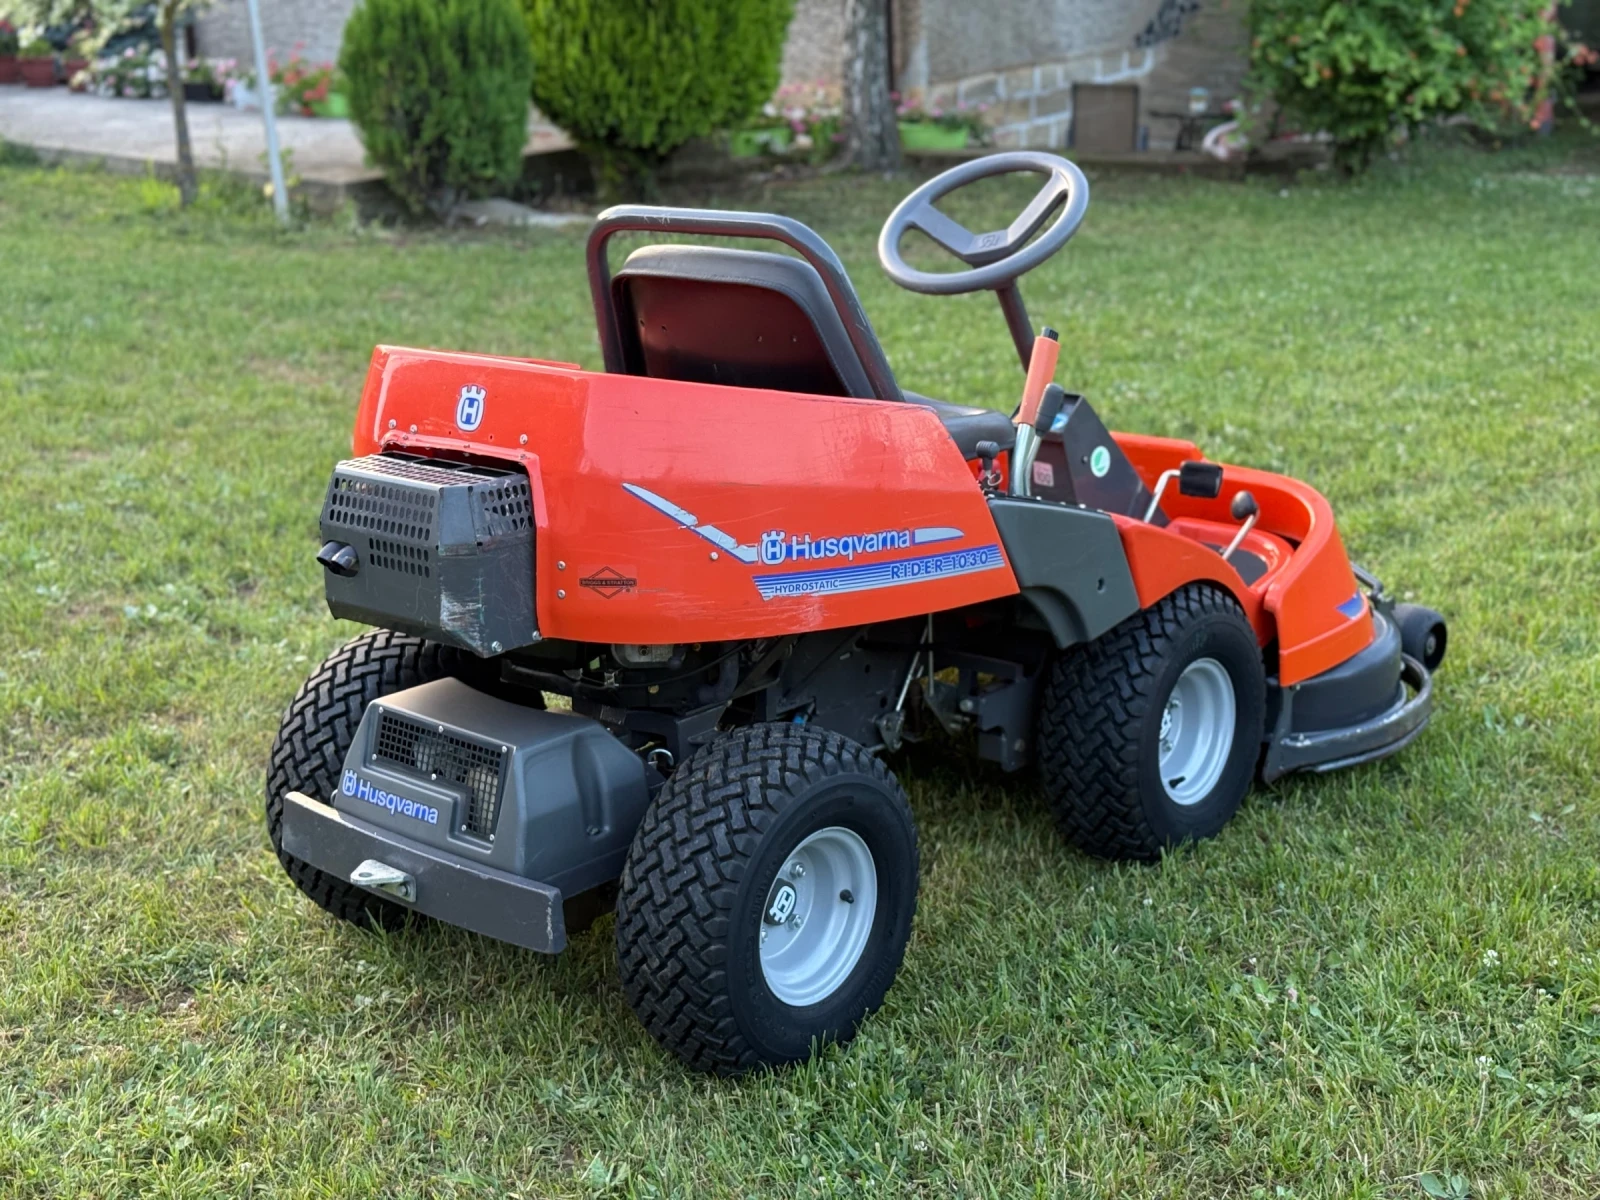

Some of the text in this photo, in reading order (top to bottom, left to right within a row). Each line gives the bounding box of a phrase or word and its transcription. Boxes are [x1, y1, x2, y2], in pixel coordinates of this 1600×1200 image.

[791, 529, 910, 561] Husqvarna
[891, 551, 988, 580] RIDER 1030
[774, 579, 839, 594] HYDROSTATIC
[357, 779, 439, 825] Husqvarna
